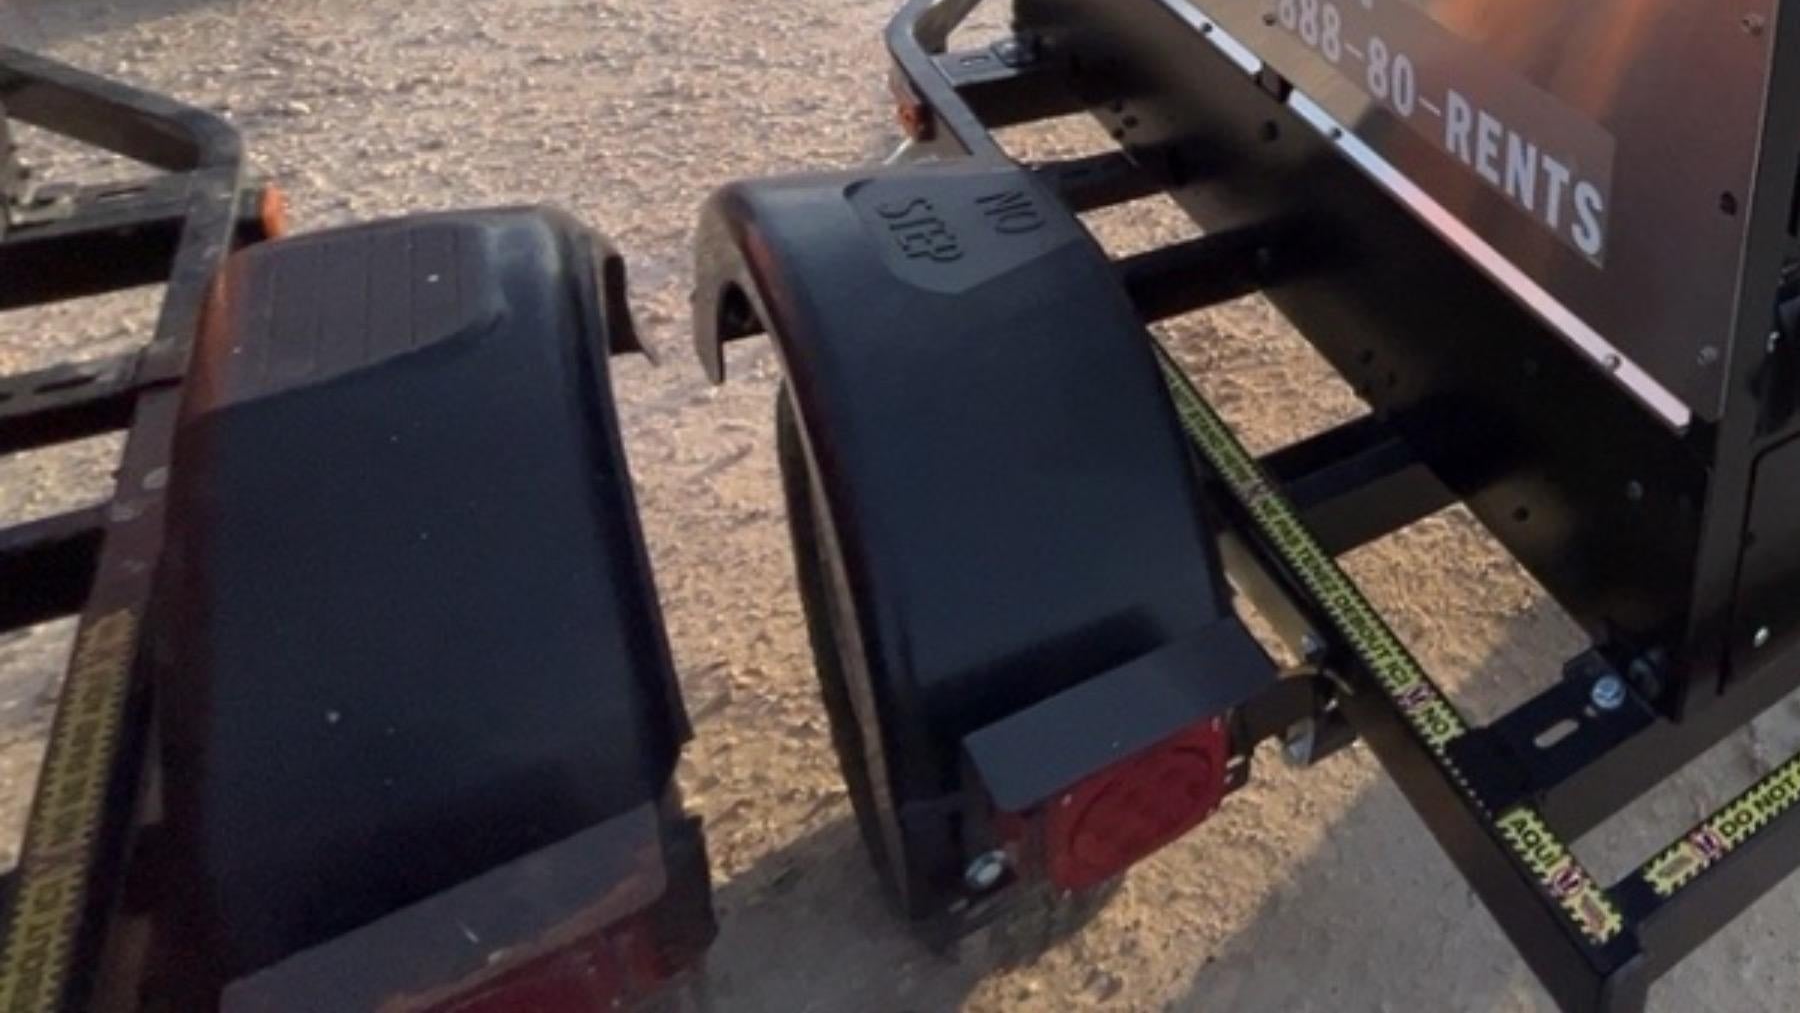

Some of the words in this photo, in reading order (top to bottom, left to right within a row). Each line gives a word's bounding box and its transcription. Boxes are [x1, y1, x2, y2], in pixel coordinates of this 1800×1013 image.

[875, 197, 965, 263] STEP
[975, 191, 1047, 234] NO
[1718, 810, 1753, 839] DO
[1754, 774, 1798, 812] NOT
